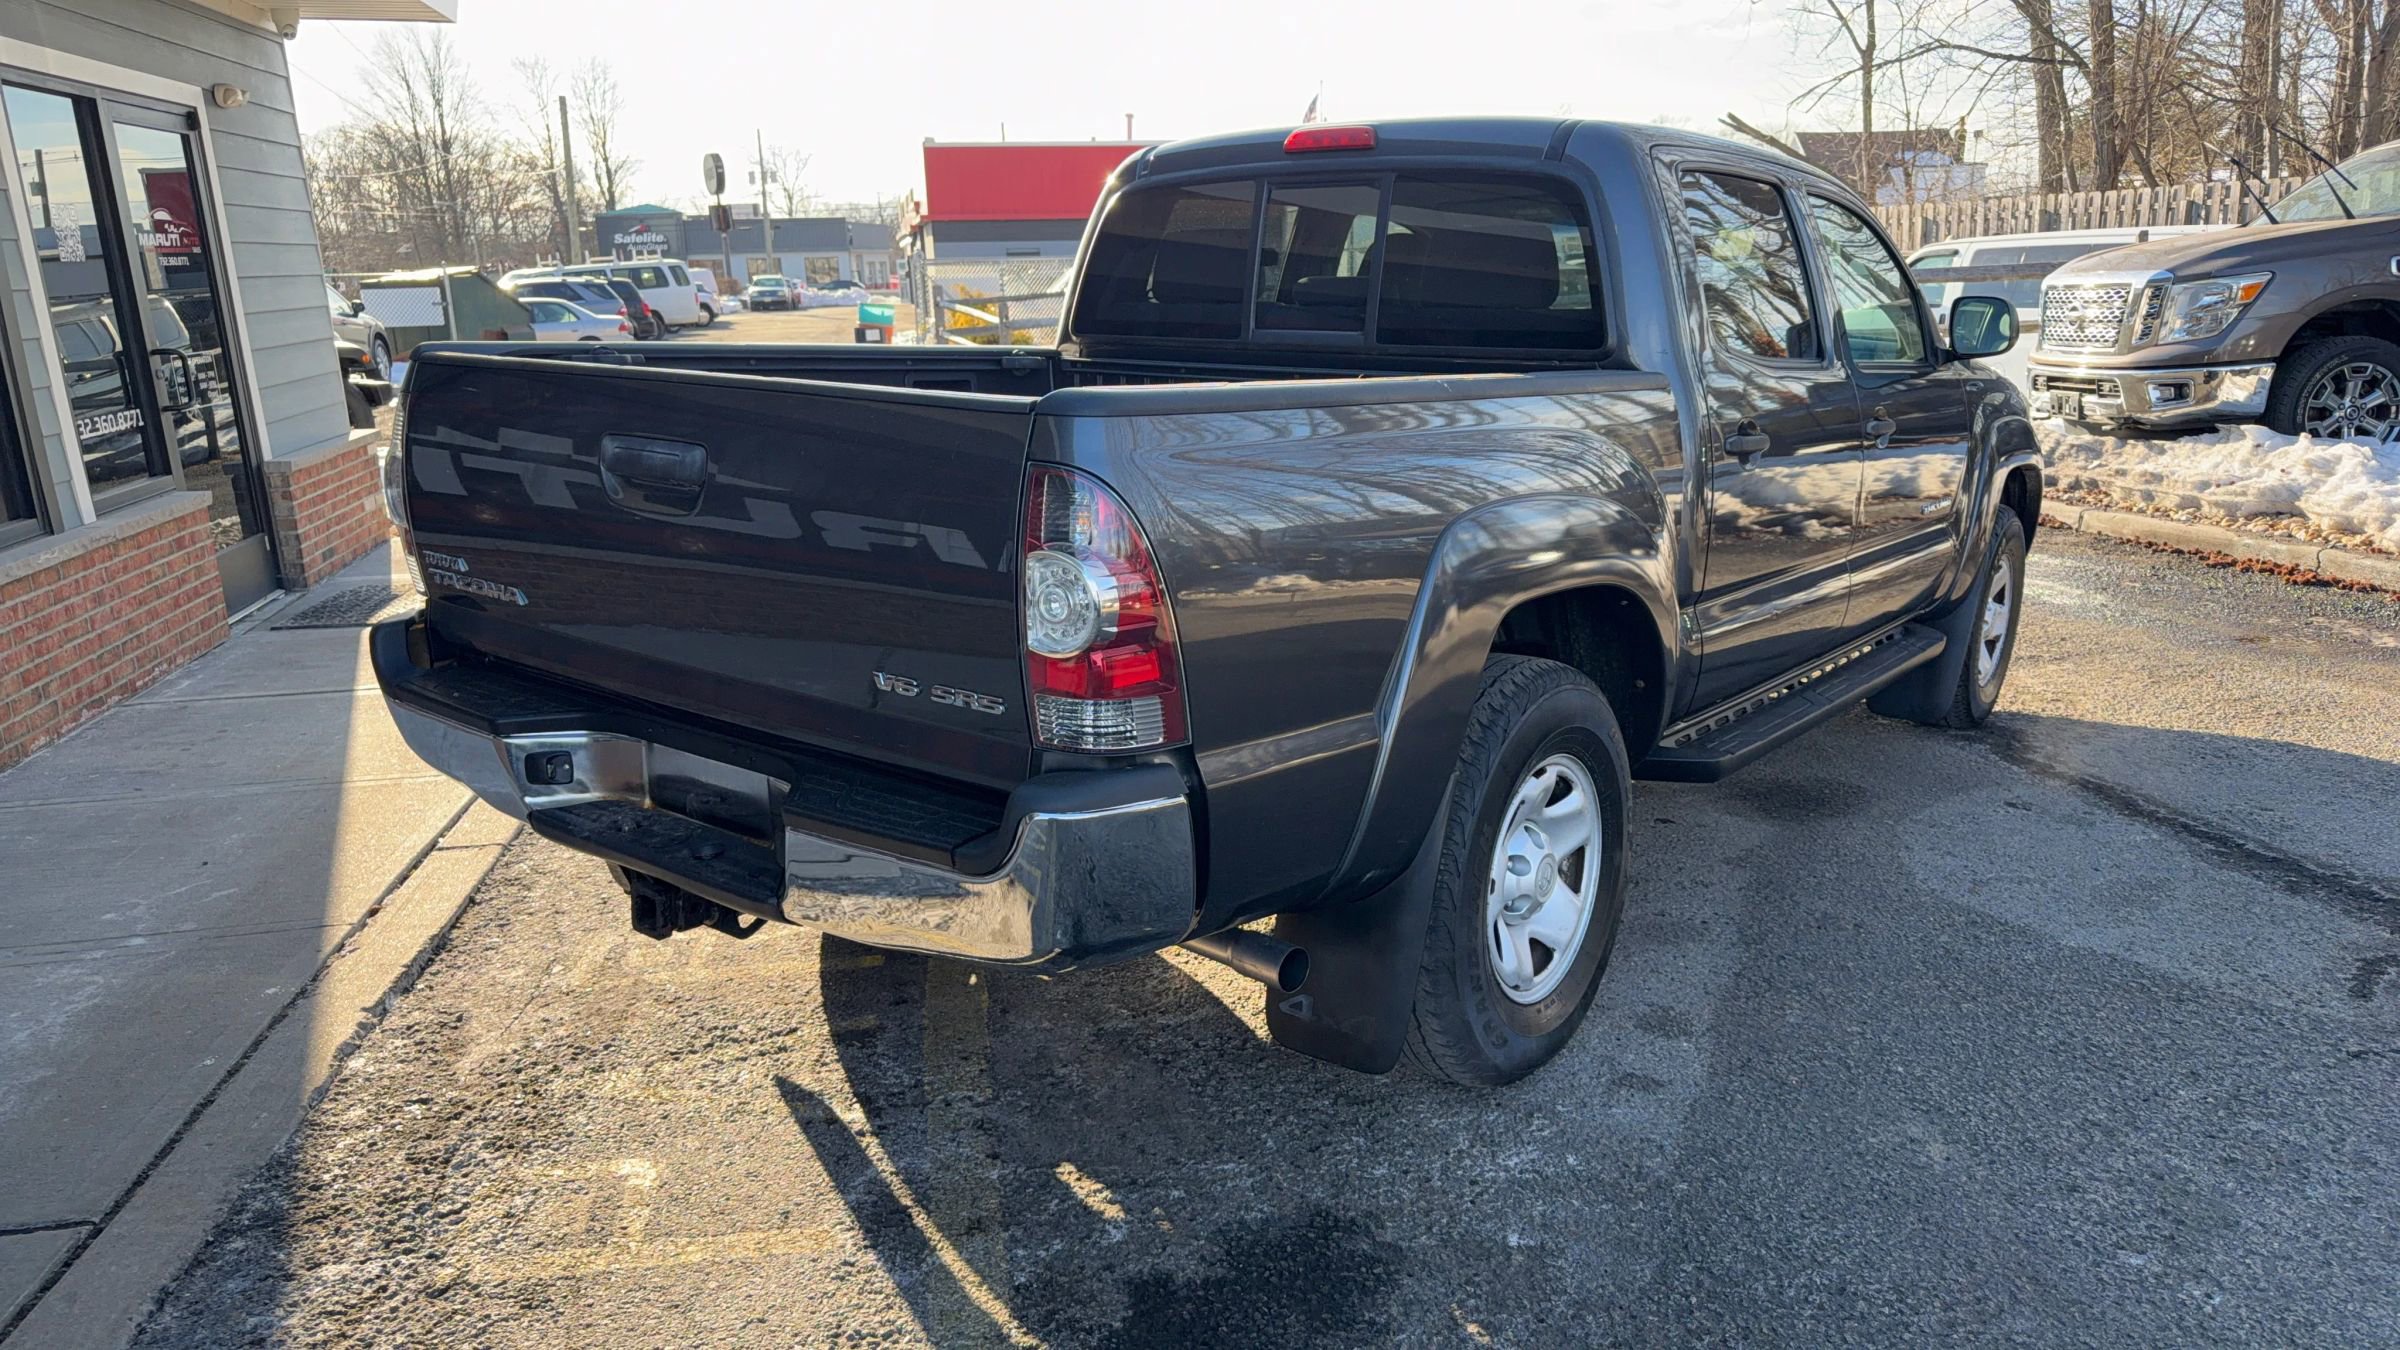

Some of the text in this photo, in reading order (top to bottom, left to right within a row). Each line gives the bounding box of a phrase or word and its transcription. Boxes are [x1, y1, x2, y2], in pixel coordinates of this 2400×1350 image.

[138, 233, 181, 246] MARUTI
[77, 408, 145, 440] 32.360.8771
[422, 550, 469, 572] TOYOTA
[428, 567, 529, 606] TACOMA
[872, 671, 920, 697] V6
